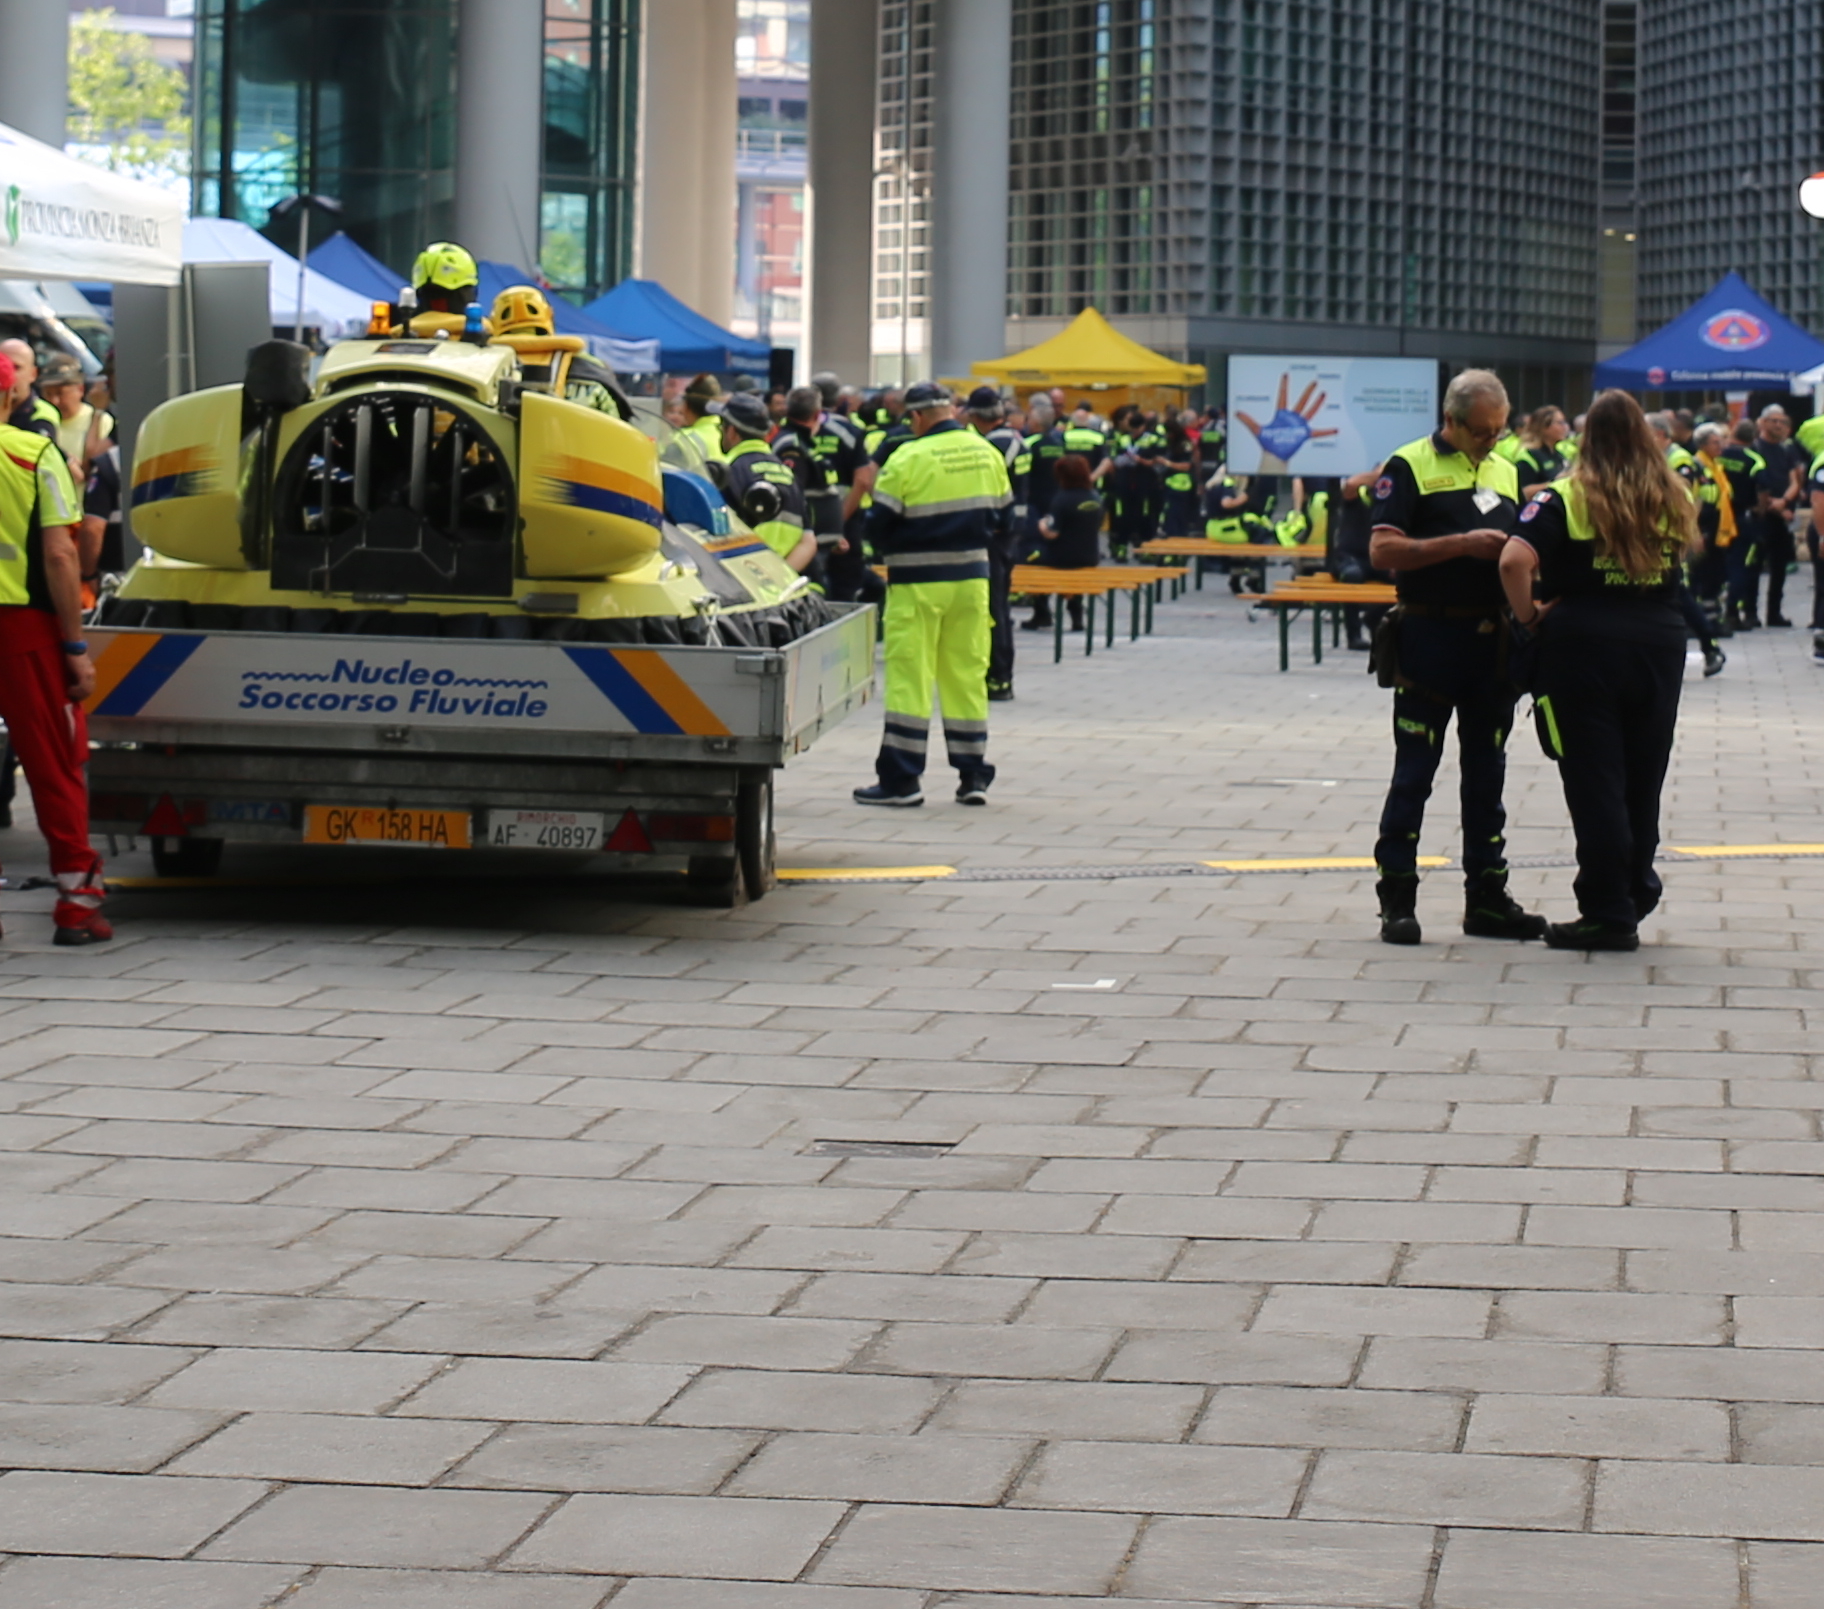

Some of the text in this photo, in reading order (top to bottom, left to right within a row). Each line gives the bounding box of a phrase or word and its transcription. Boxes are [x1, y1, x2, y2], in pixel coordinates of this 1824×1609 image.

[331, 659, 456, 687] Nucleo
[238, 684, 549, 718] Soccorso Fluviale
[326, 809, 357, 841] GK
[376, 810, 413, 843] 158
[419, 813, 449, 846] HA
[516, 810, 577, 825] RIMORCHIO
[494, 824, 598, 849] AF 40897
